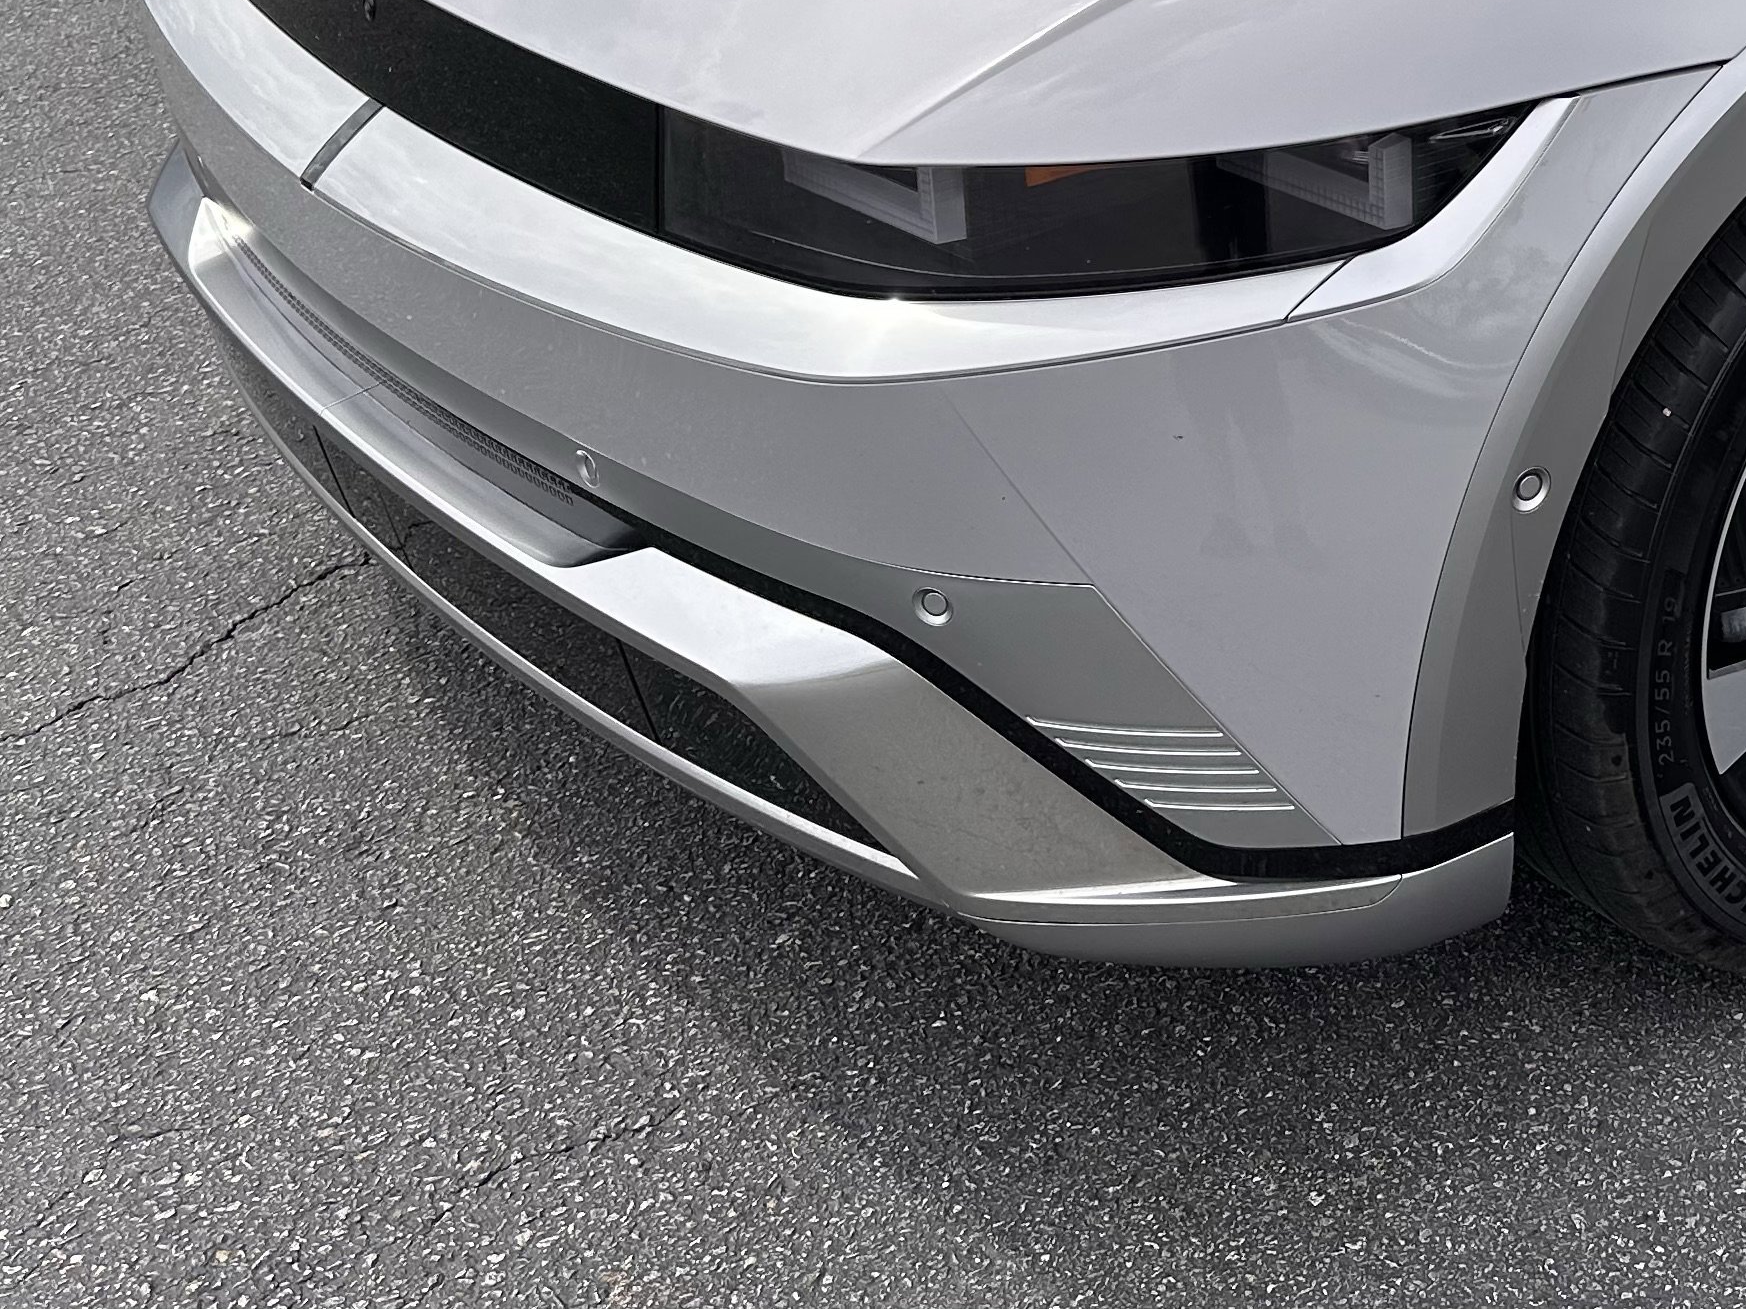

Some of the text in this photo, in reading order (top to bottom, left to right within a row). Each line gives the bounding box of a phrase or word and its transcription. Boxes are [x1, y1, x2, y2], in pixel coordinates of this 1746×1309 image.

[1654, 596, 1677, 767] 235/55 R 19
